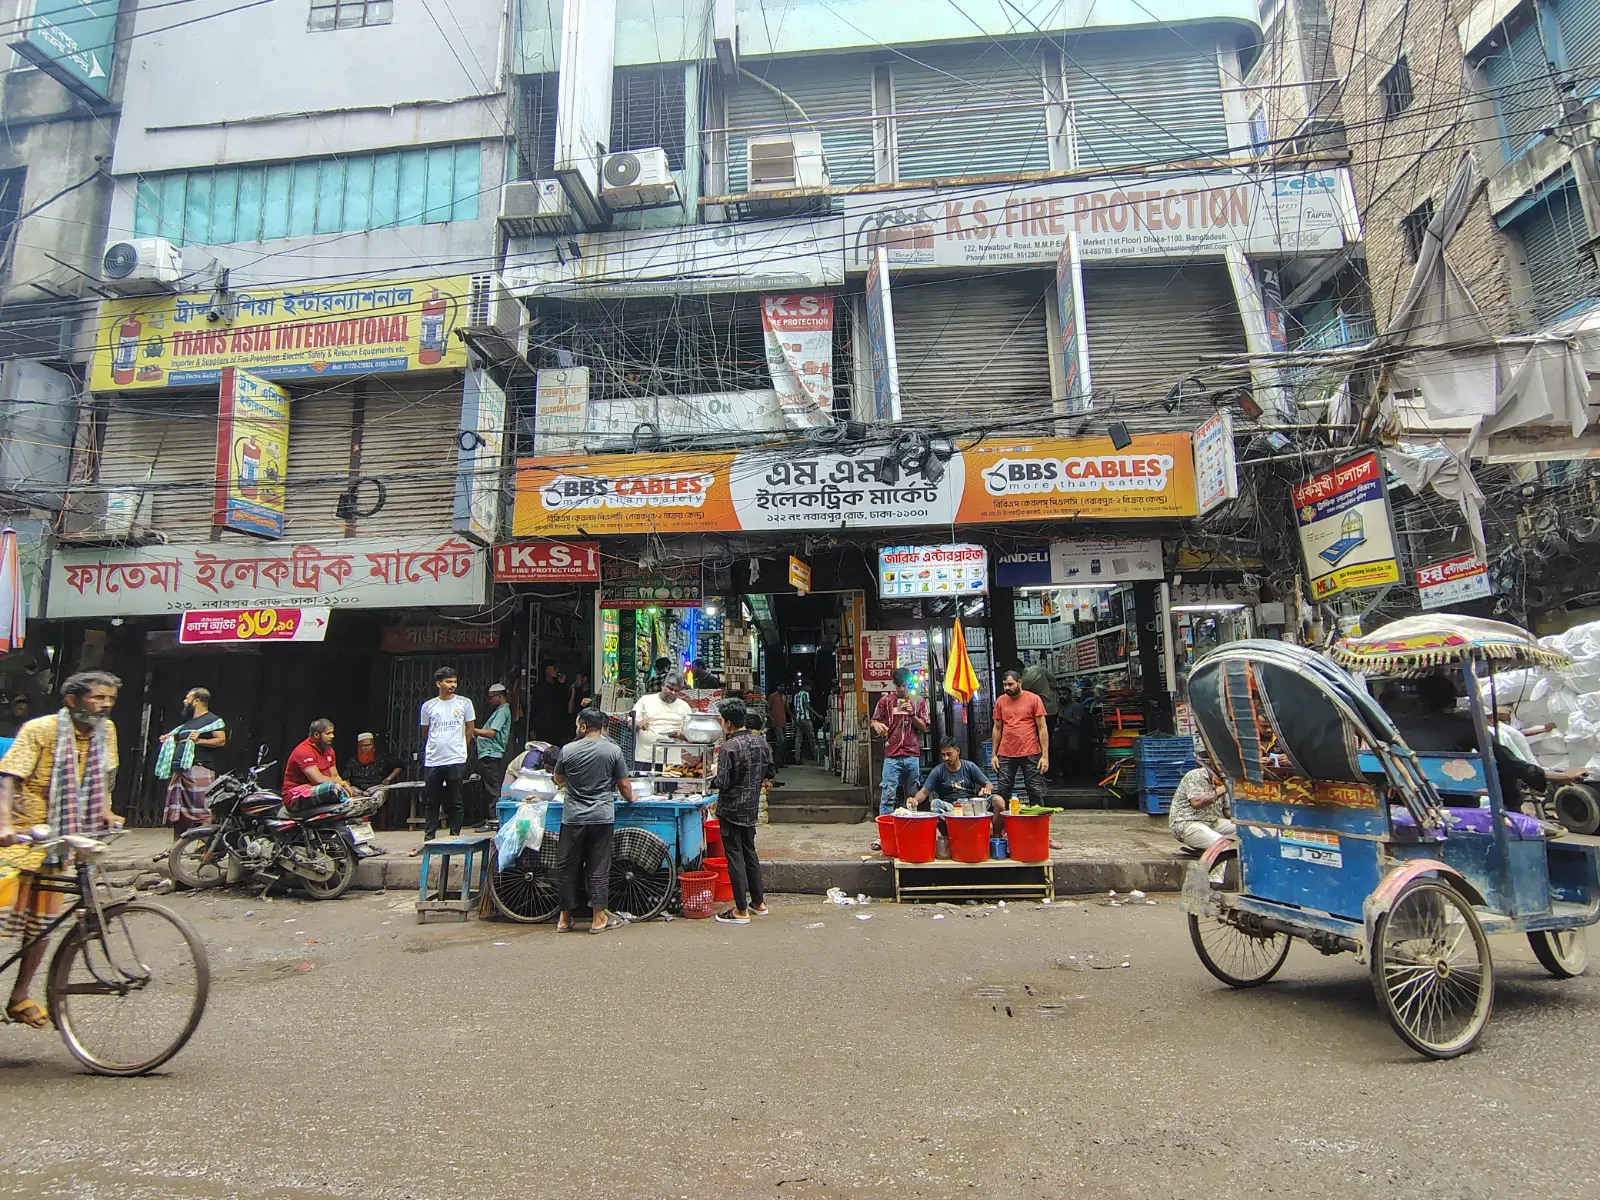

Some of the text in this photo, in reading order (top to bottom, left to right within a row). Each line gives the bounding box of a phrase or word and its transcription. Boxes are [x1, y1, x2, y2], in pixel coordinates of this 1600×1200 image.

[945, 186, 1250, 241] K.S. FIRE PROTECTION
[963, 244, 977, 253] 122,
[979, 243, 1012, 254] Nawabpur
[1034, 240, 1055, 249] M.M.P
[1107, 238, 1120, 246] (1st
[1121, 237, 1142, 246] Floor)
[966, 253, 988, 261] Phone:
[765, 296, 829, 316] K.S.
[783, 318, 829, 326] PROTECTION
[173, 315, 408, 357] TRANS ASIA INTERNATIONAL
[202, 356, 229, 368] Suppliers
[308, 350, 327, 361] Safety
[328, 350, 333, 358] &
[359, 345, 395, 357] Equipments
[1009, 459, 1161, 482] BBS CABLES
[564, 476, 702, 497] BBS CABLES
[1009, 477, 1163, 490] more than safety
[756, 481, 938, 510] ইলেকট্রিক মার্কেট
[993, 500, 1020, 509] বিবিএস
[1123, 495, 1144, 504] বিক্রয়
[767, 514, 786, 522] ১২২
[788, 513, 801, 521] নং
[803, 512, 841, 523] নবাবপুর
[511, 546, 582, 567] K.S.
[884, 551, 920, 564] জারিফ
[999, 552, 1048, 564] ANDELI
[64, 538, 476, 596] ফাতেমা ইলেকট্রিক মার্কেট
[167, 601, 196, 611] ১২৩,
[291, 595, 360, 606] ঢাকা-১১০০
[187, 621, 208, 632] ক্যাশ
[209, 618, 237, 630] আউট
[865, 658, 895, 669] বিকাশ
[869, 668, 891, 678] করুন
